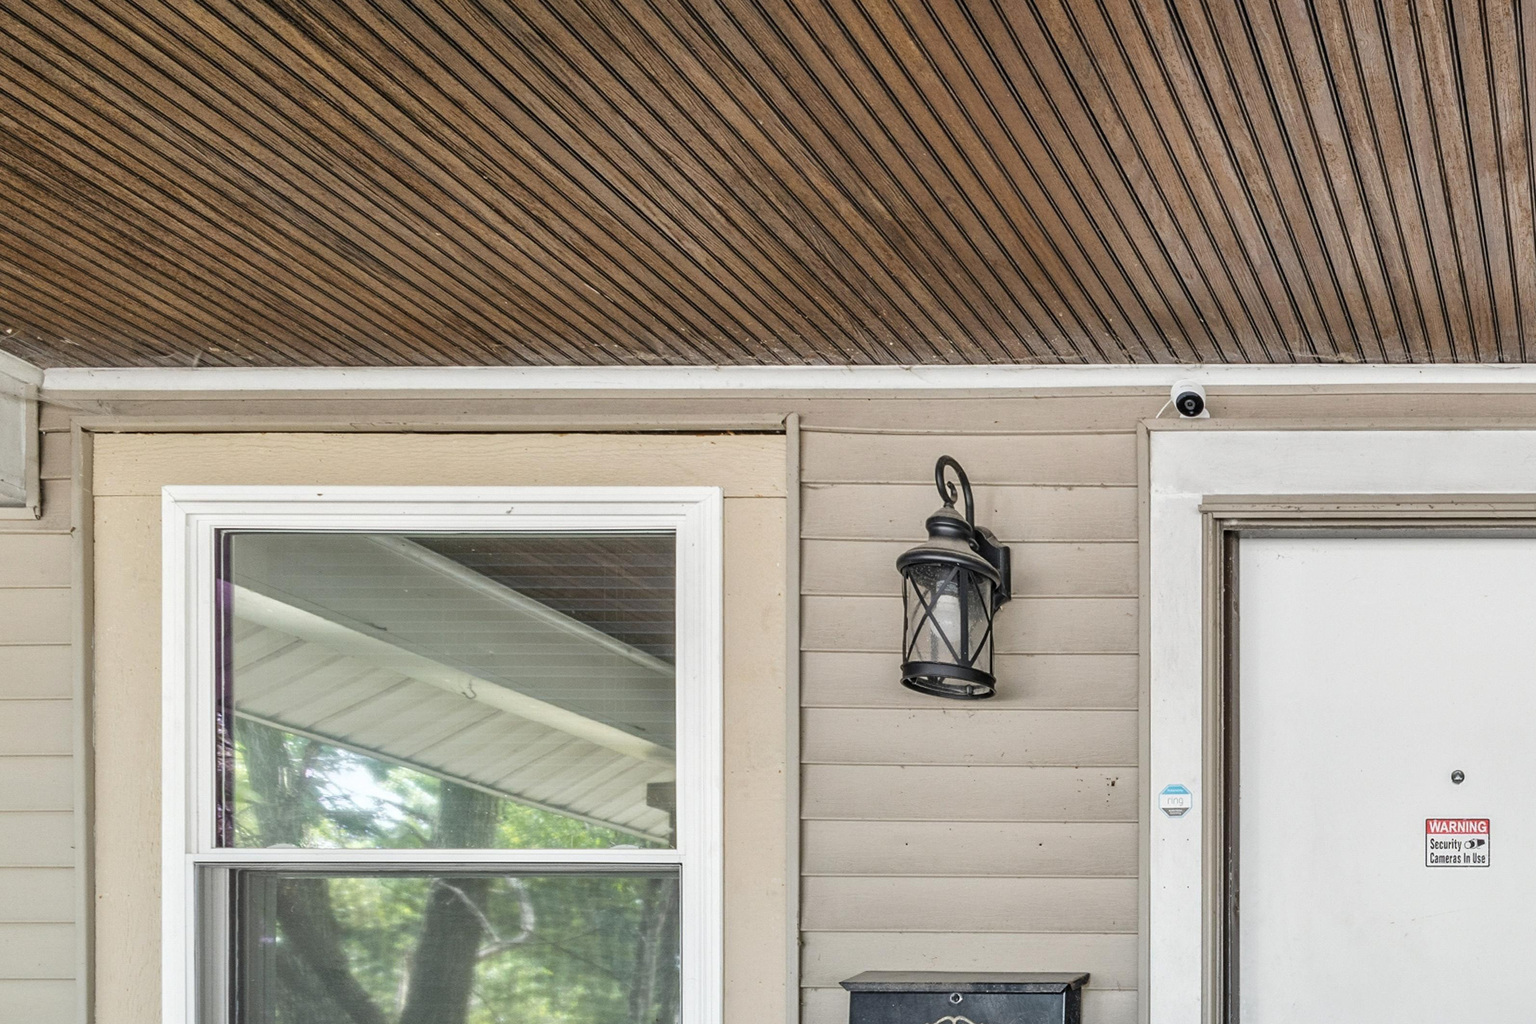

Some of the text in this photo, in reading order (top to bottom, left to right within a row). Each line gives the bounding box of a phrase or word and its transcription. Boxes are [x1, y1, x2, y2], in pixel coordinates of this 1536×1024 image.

[1167, 797, 1184, 806] ring
[1429, 821, 1487, 833] WARNING
[1430, 838, 1462, 852] Security
[1430, 852, 1486, 864] Cameras In Use
